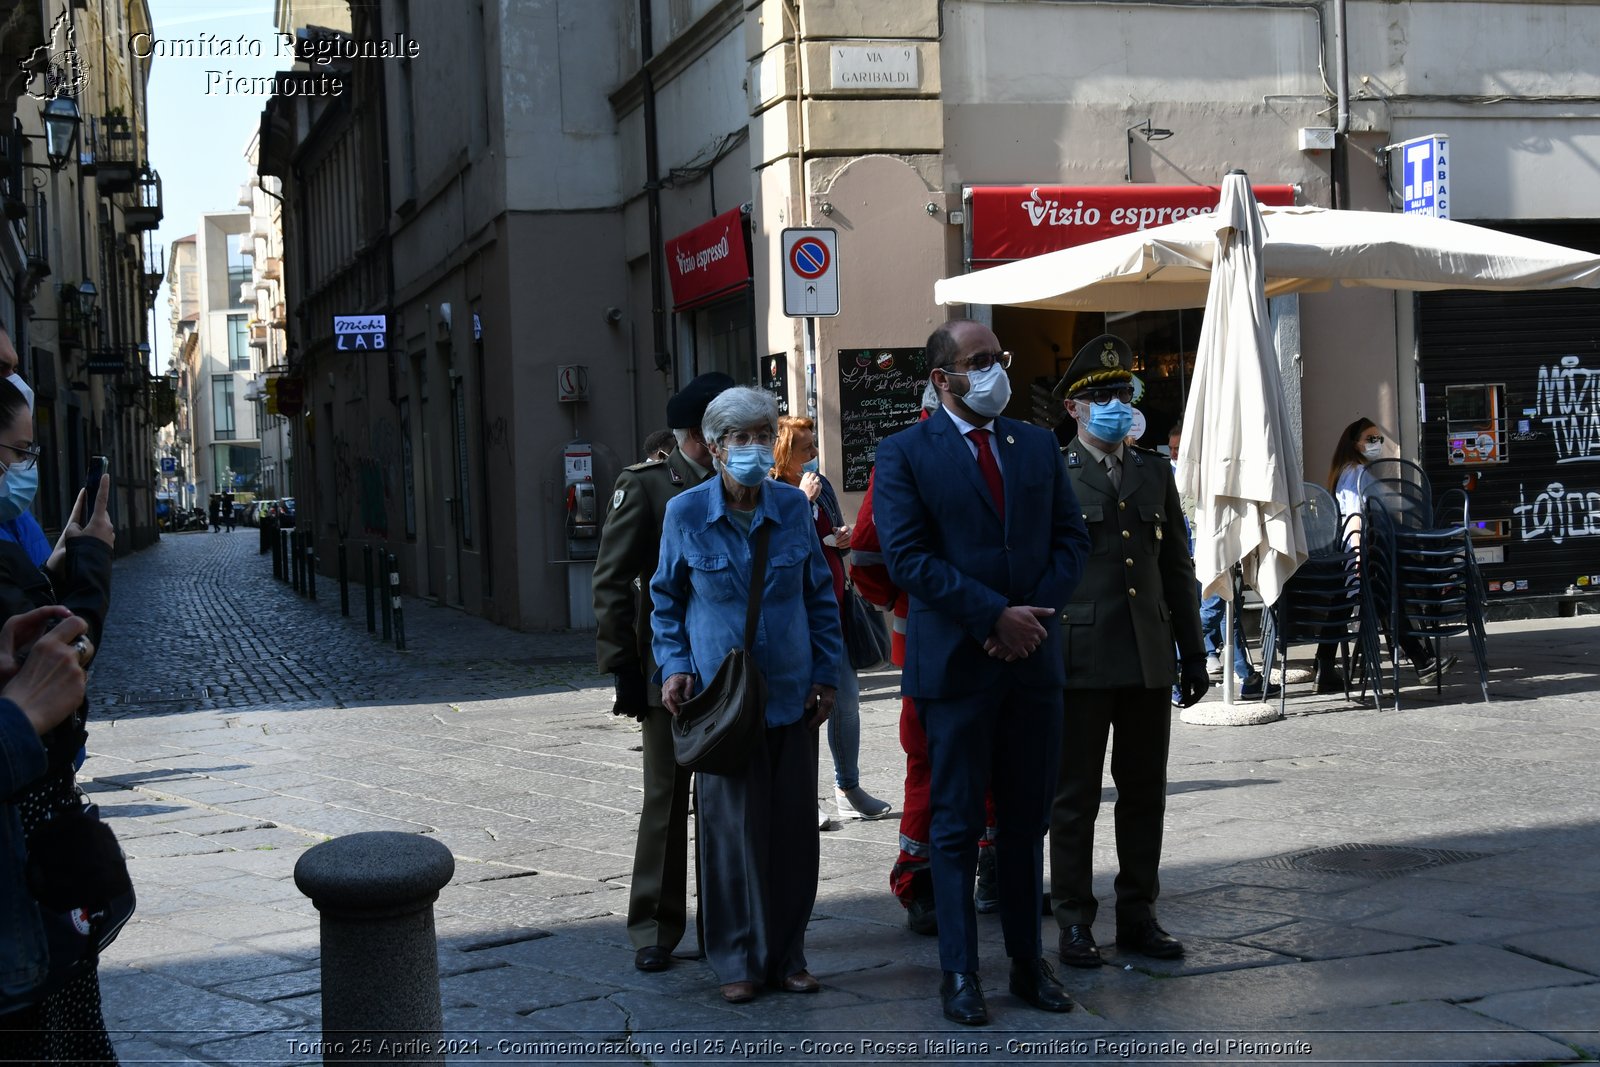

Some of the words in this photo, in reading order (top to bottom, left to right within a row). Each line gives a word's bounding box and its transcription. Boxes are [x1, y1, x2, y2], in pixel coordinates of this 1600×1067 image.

[866, 52, 883, 62] VIA
[904, 50, 911, 61] 9
[842, 72, 910, 83] GARIBALDI
[1021, 194, 1101, 226] Vizio
[1110, 203, 1220, 231] espres
[675, 249, 696, 275] Vizio
[696, 236, 729, 271] espresso
[163, 460, 172, 471] P
